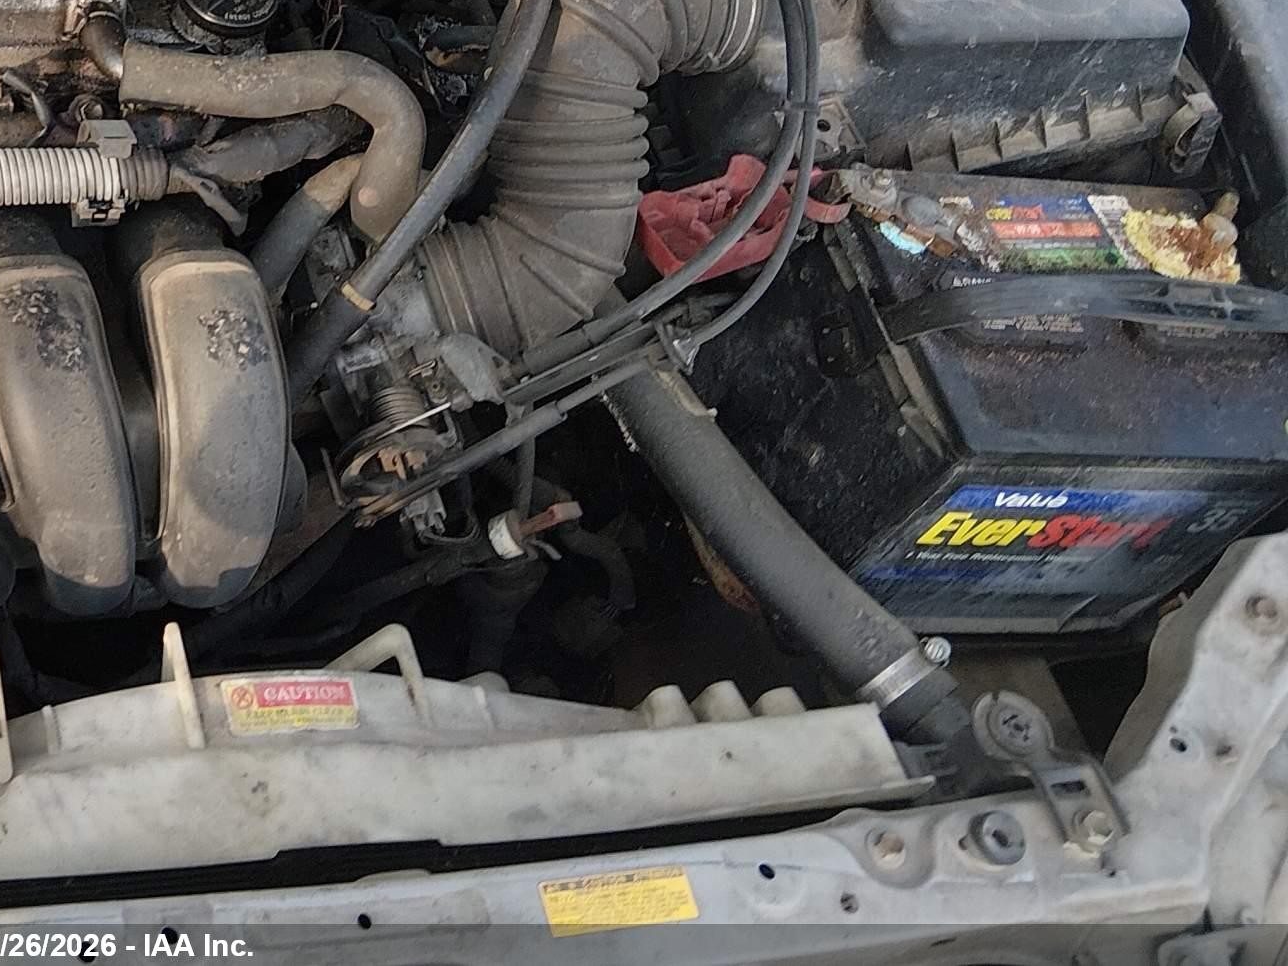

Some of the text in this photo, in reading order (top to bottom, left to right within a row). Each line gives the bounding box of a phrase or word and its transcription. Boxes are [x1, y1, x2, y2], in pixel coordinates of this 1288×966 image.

[994, 491, 1069, 509] Value
[915, 511, 1175, 551] EverStart
[1186, 508, 1249, 534] 35
[263, 684, 347, 702] CAUTION
